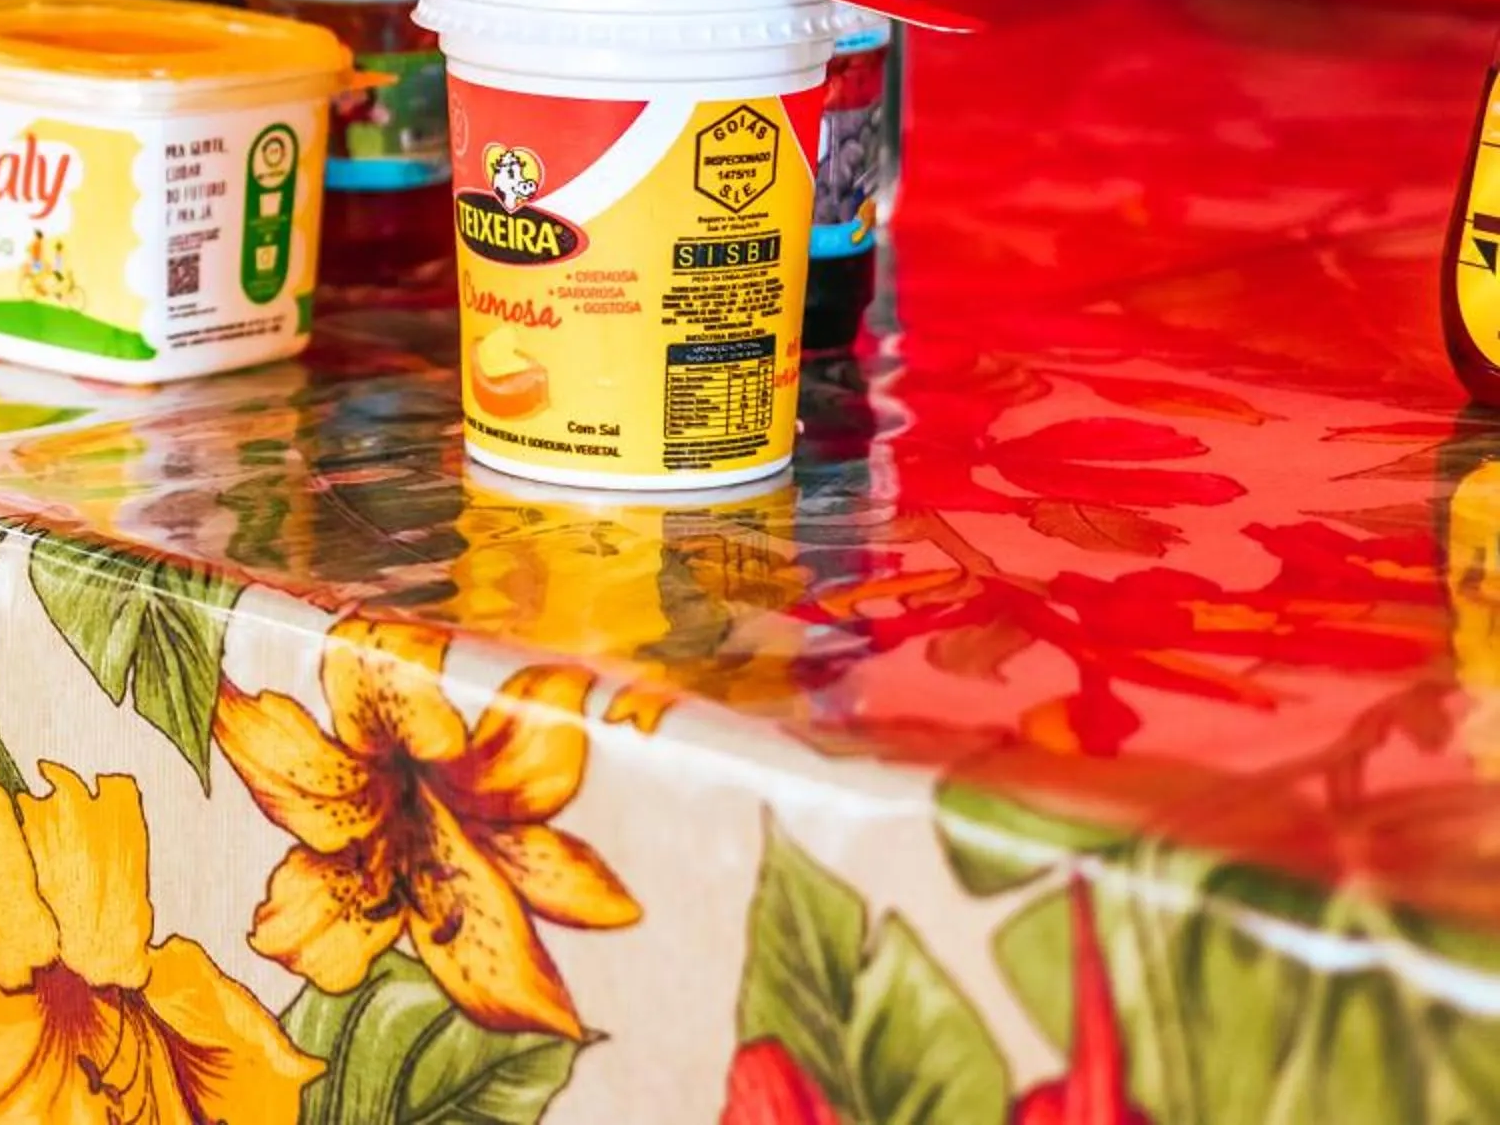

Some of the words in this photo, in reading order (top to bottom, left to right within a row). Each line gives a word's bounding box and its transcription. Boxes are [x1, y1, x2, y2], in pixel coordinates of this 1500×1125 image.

[457, 199, 560, 256] TEIXEIRA
[678, 238, 775, 266] SISBI
[575, 271, 639, 283] CREMOSA
[463, 269, 563, 329] Cremosa
[557, 286, 625, 299] SABOROSA
[583, 302, 642, 314] GOSTOSA
[567, 421, 596, 435] Com
[599, 424, 620, 436] Sal
[528, 437, 573, 454] GORDURA
[574, 444, 622, 458] VEGETAL
